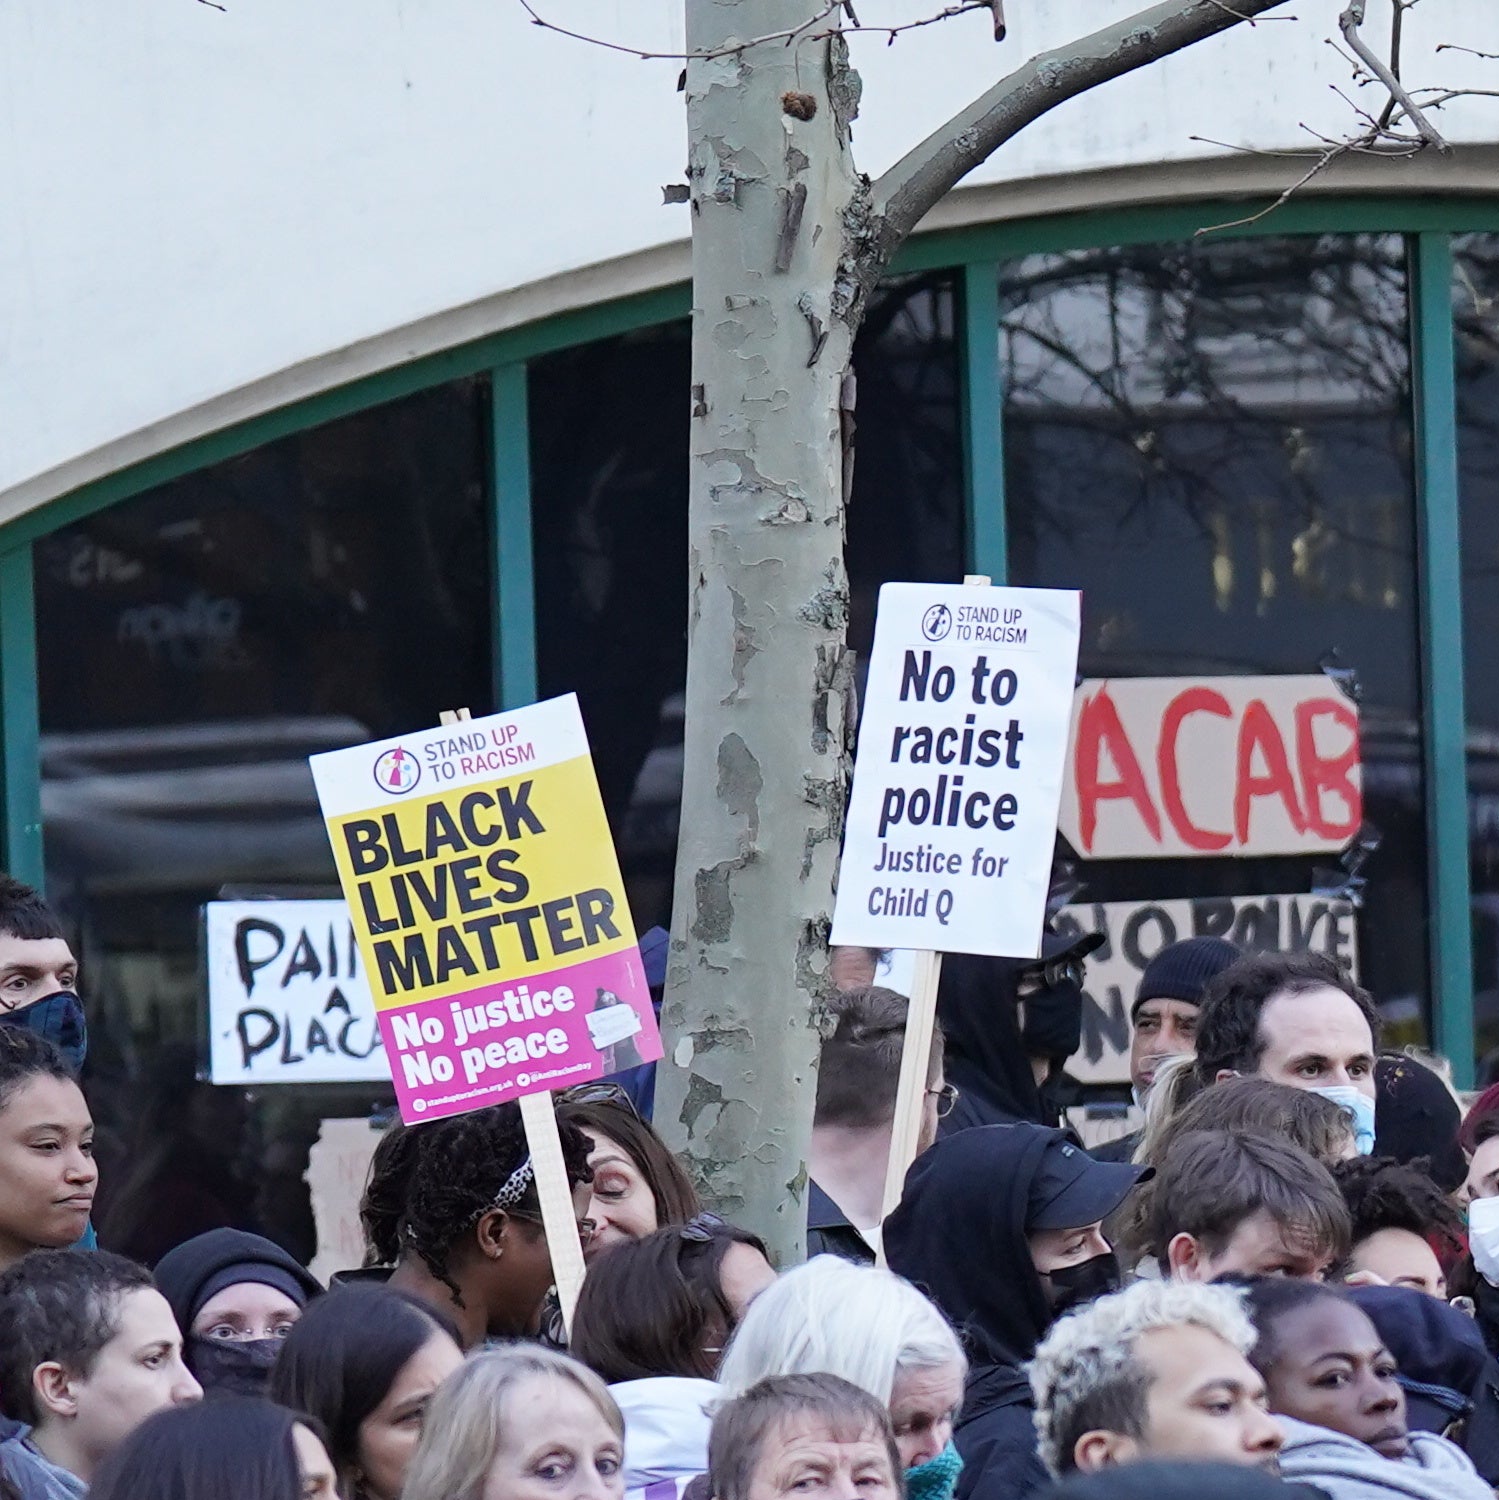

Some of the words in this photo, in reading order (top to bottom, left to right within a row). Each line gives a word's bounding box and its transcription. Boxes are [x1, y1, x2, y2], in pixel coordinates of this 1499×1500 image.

[956, 624, 972, 640] TO
[975, 626, 1027, 644] RACISM
[958, 606, 1000, 624] STAND
[1004, 608, 1022, 624] UP
[899, 650, 955, 703] No
[971, 655, 1018, 706] to
[424, 732, 487, 761] STAND
[491, 725, 519, 746] UP
[428, 761, 456, 782] TO
[460, 743, 536, 776] RACISM
[890, 713, 1024, 770] racist
[1074, 680, 1363, 856] ACAB
[342, 780, 546, 876] BLACK
[877, 774, 1018, 838] police
[873, 842, 962, 875] Justice
[971, 847, 1009, 878] for
[357, 849, 530, 935] LIVES
[868, 886, 929, 918] Child
[935, 888, 954, 926] Q
[373, 888, 622, 995] MATTER
[390, 1011, 444, 1050] No
[450, 984, 575, 1046] justice
[400, 1050, 454, 1088] No
[461, 1027, 569, 1084] peace
